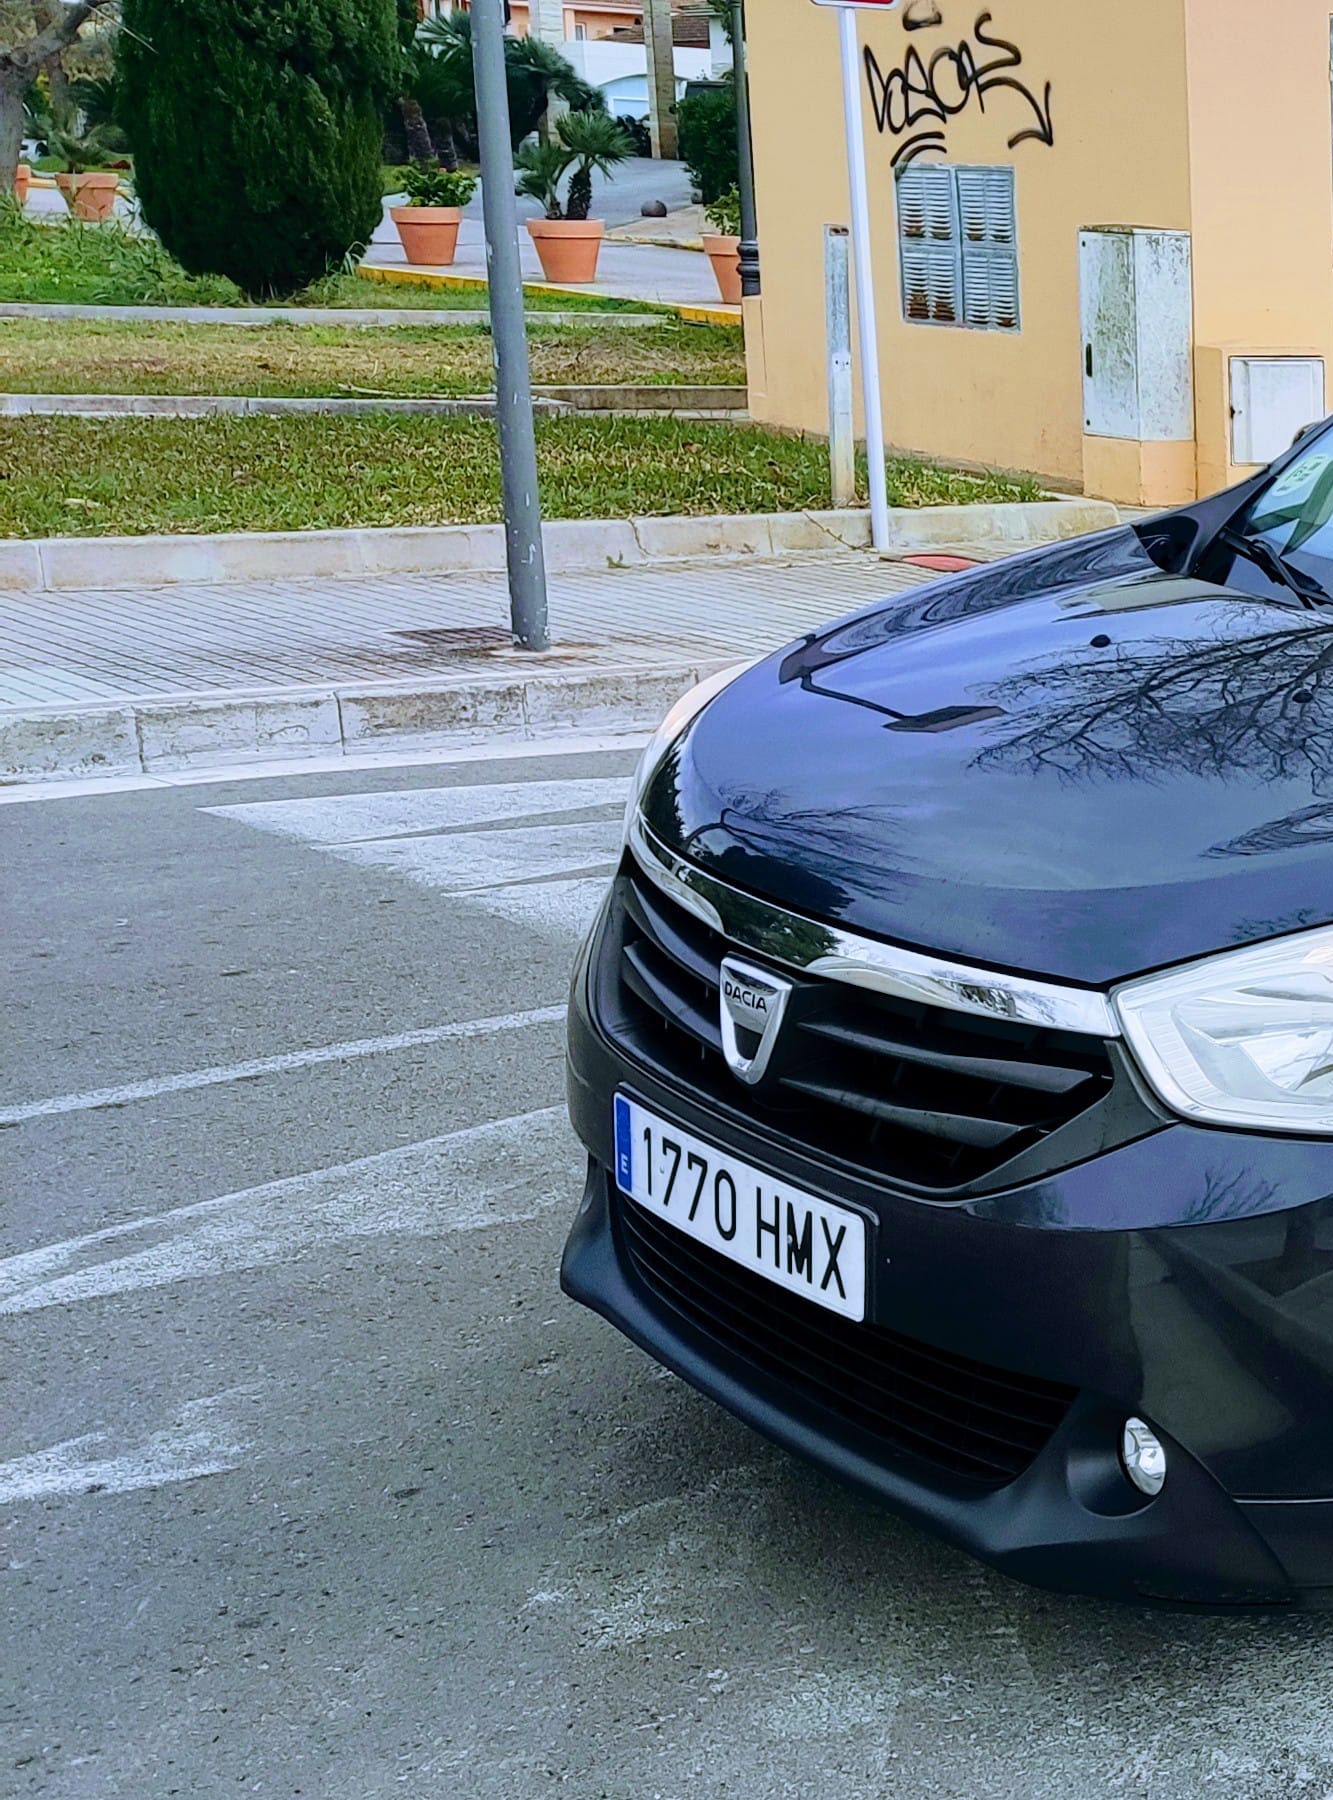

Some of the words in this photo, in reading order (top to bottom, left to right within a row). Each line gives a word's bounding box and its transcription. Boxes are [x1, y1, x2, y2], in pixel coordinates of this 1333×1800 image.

[724, 981, 767, 1013] DACIA
[620, 1153, 629, 1175] E
[643, 1126, 737, 1242] 1770
[756, 1186, 847, 1301] HMX
